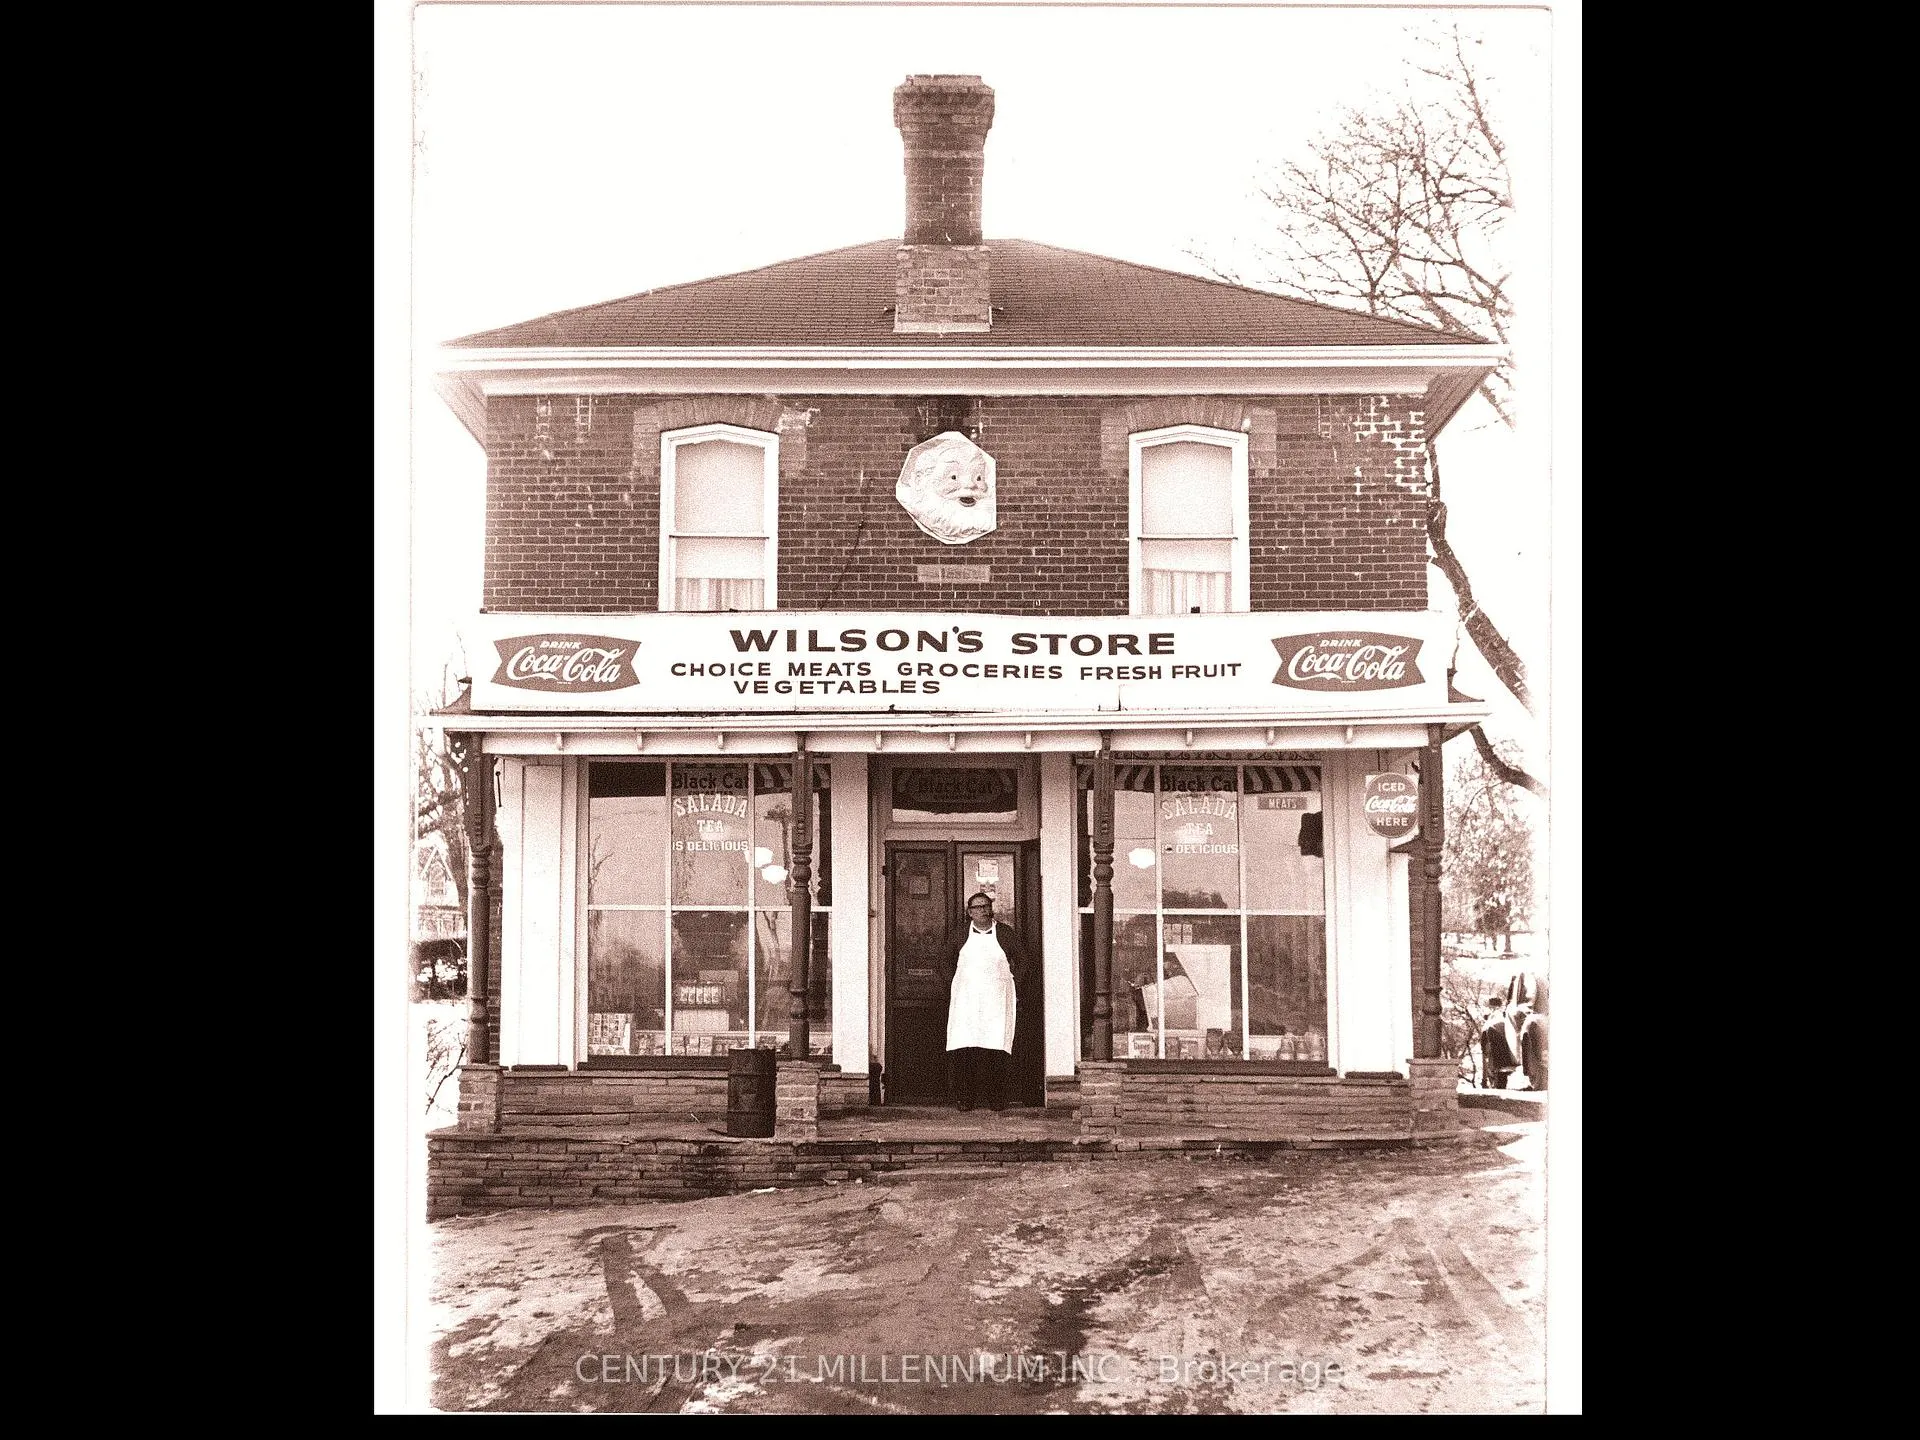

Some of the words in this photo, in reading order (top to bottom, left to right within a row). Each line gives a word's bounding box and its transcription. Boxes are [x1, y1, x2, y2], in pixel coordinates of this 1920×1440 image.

[540, 641, 582, 649] DRINK
[730, 626, 983, 653] WILSON'S
[1011, 632, 1174, 656] STORE
[1320, 639, 1363, 647] DRINK
[506, 646, 626, 683] Coca-Cola
[1288, 645, 1409, 681] Coca-Cola
[671, 662, 771, 677] CHOICE
[789, 662, 872, 677] MEATS
[898, 663, 1063, 680] GROCERIES
[1080, 665, 1162, 680] FRESH
[1172, 663, 1242, 679] FRUIT
[733, 680, 940, 695] VEGETABLES
[672, 772, 717, 789] Black
[918, 777, 962, 793] Black
[1160, 775, 1206, 791] Black
[1378, 782, 1406, 791] ICED
[673, 793, 748, 818] SALADA
[1161, 796, 1238, 820] SALADA
[1268, 798, 1297, 809] MEATS
[697, 819, 725, 833] TEA
[1186, 822, 1213, 835] TEA
[1376, 817, 1408, 826] HERE
[687, 840, 749, 851] DELICIOUS
[1176, 844, 1238, 854] DELICIOUS
